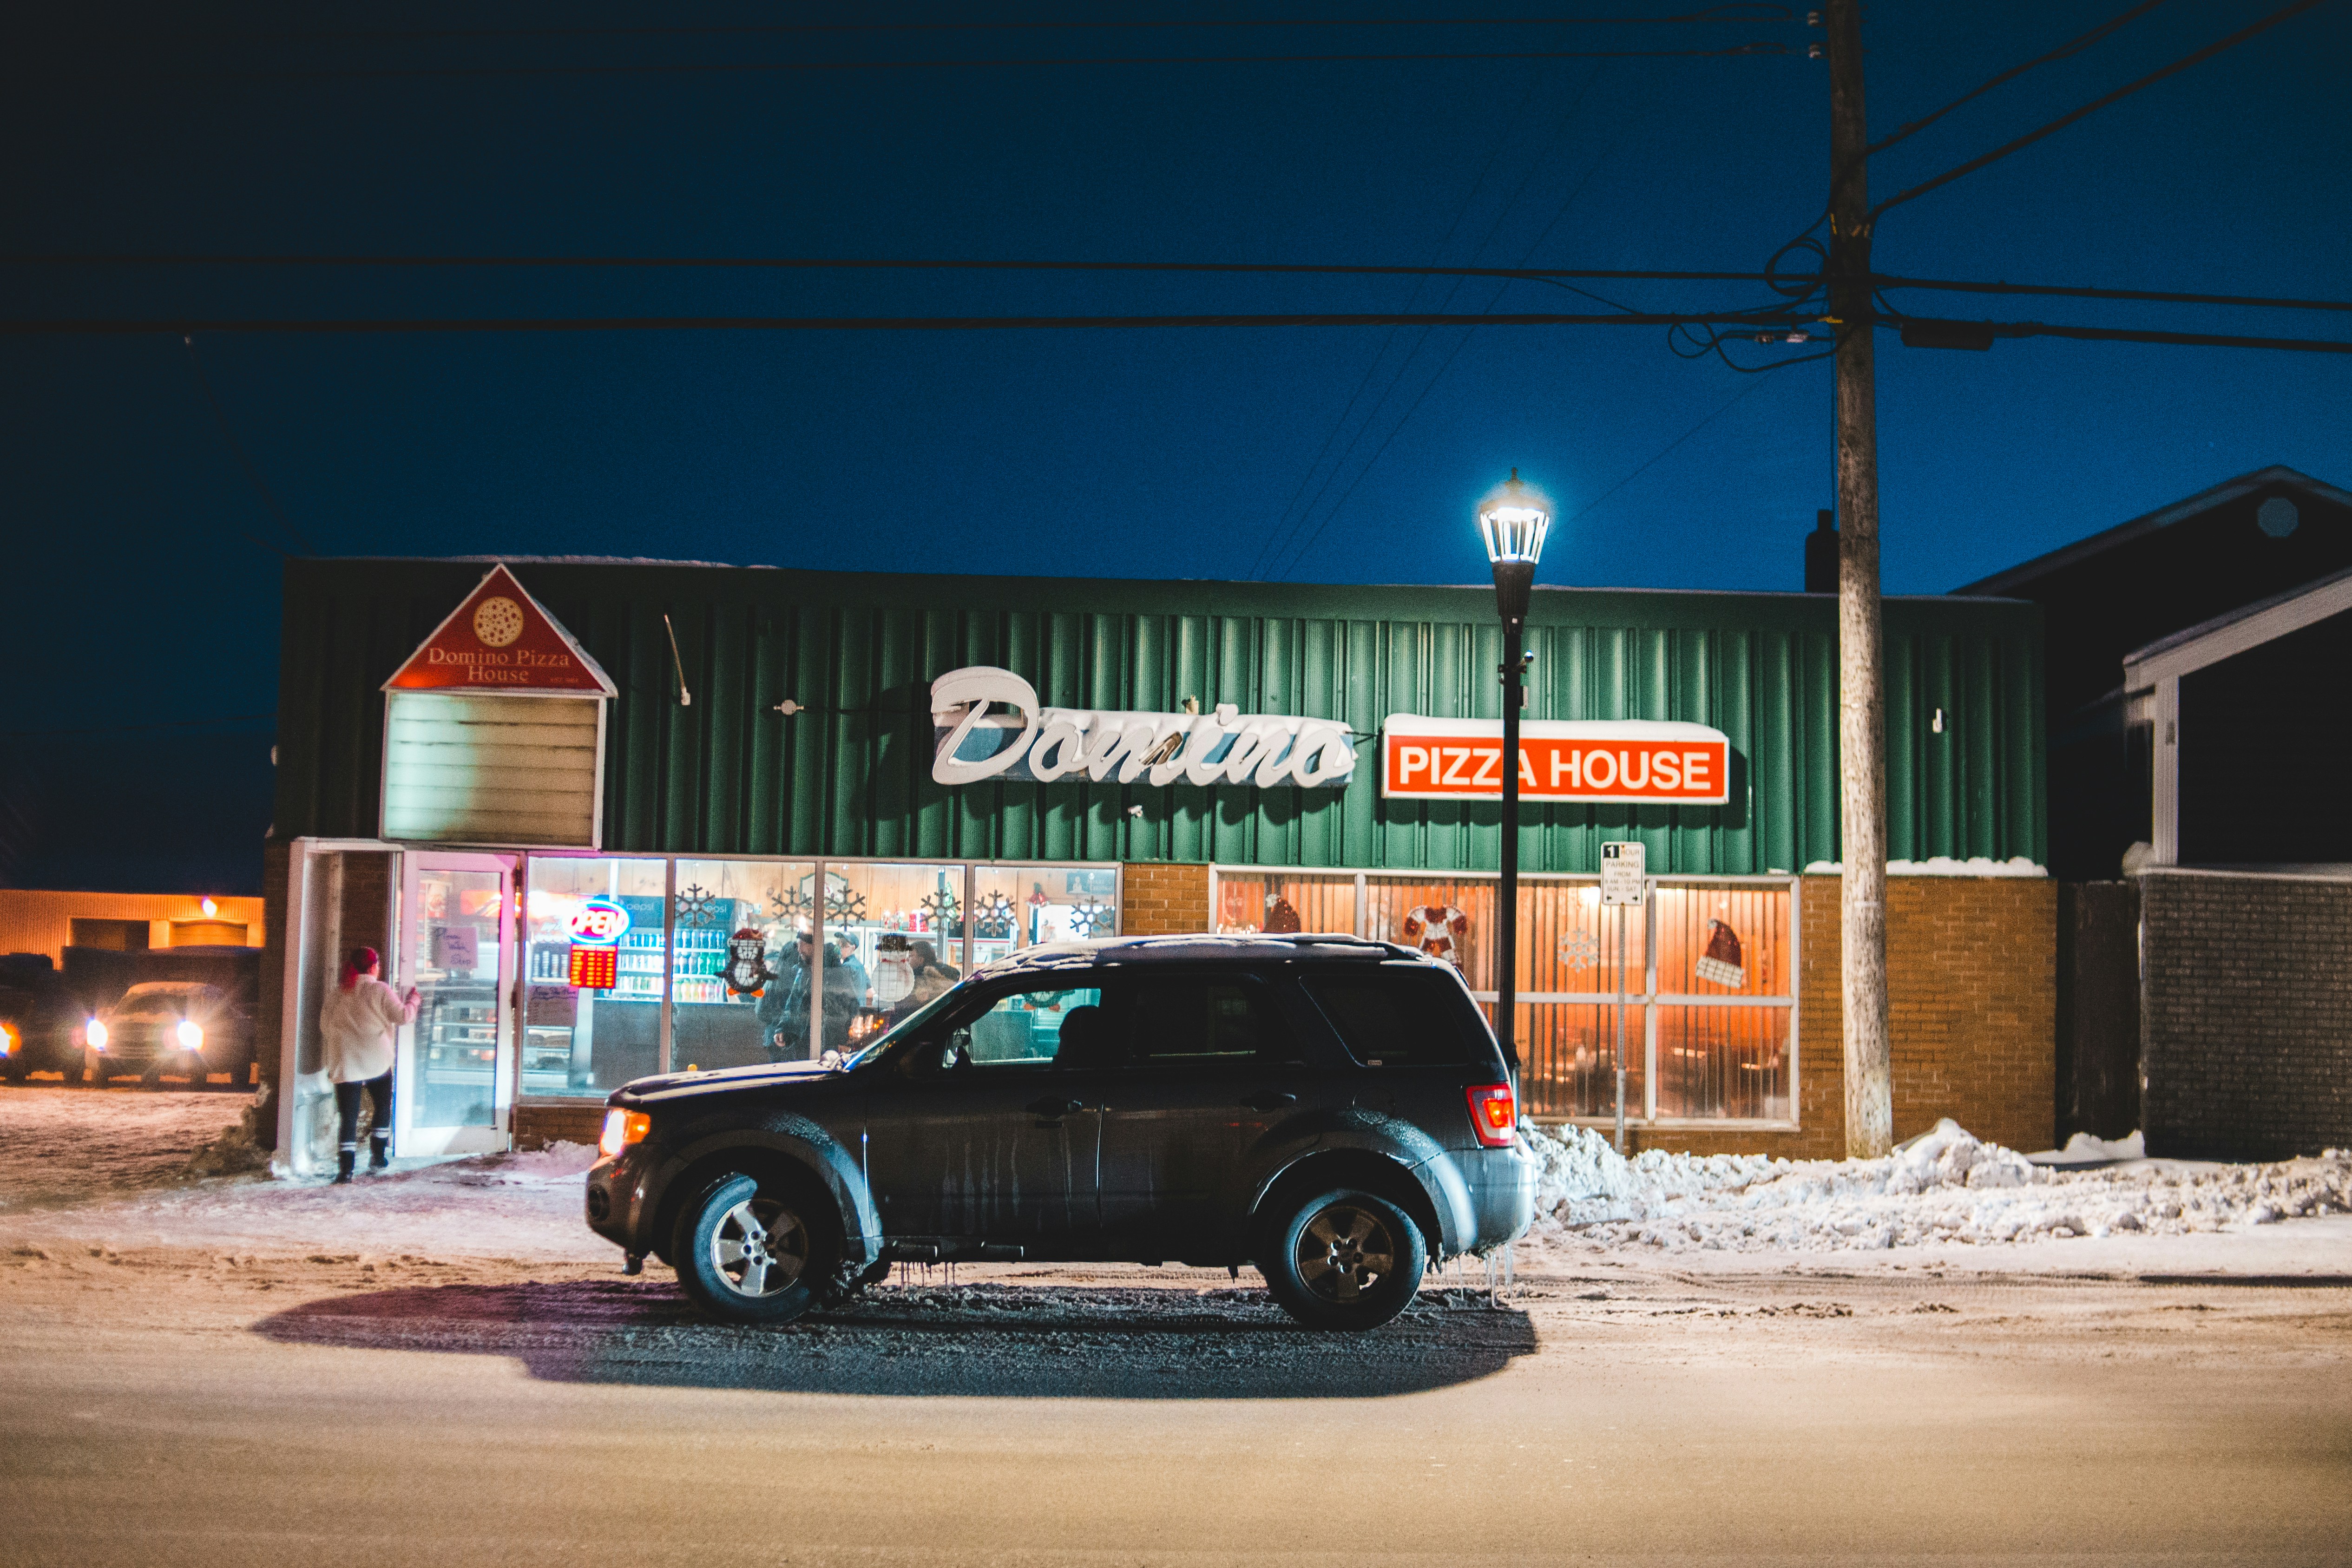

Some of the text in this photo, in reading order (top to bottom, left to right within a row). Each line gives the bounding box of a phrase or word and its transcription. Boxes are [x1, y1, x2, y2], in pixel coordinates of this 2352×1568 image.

[427, 648, 570, 667] Domino Pizza
[467, 665, 529, 682] House
[931, 666, 1357, 788] Domino
[1399, 747, 1711, 790] PIZZA HOUSE
[1607, 846, 1614, 858] 1
[567, 911, 625, 938] OPEN
